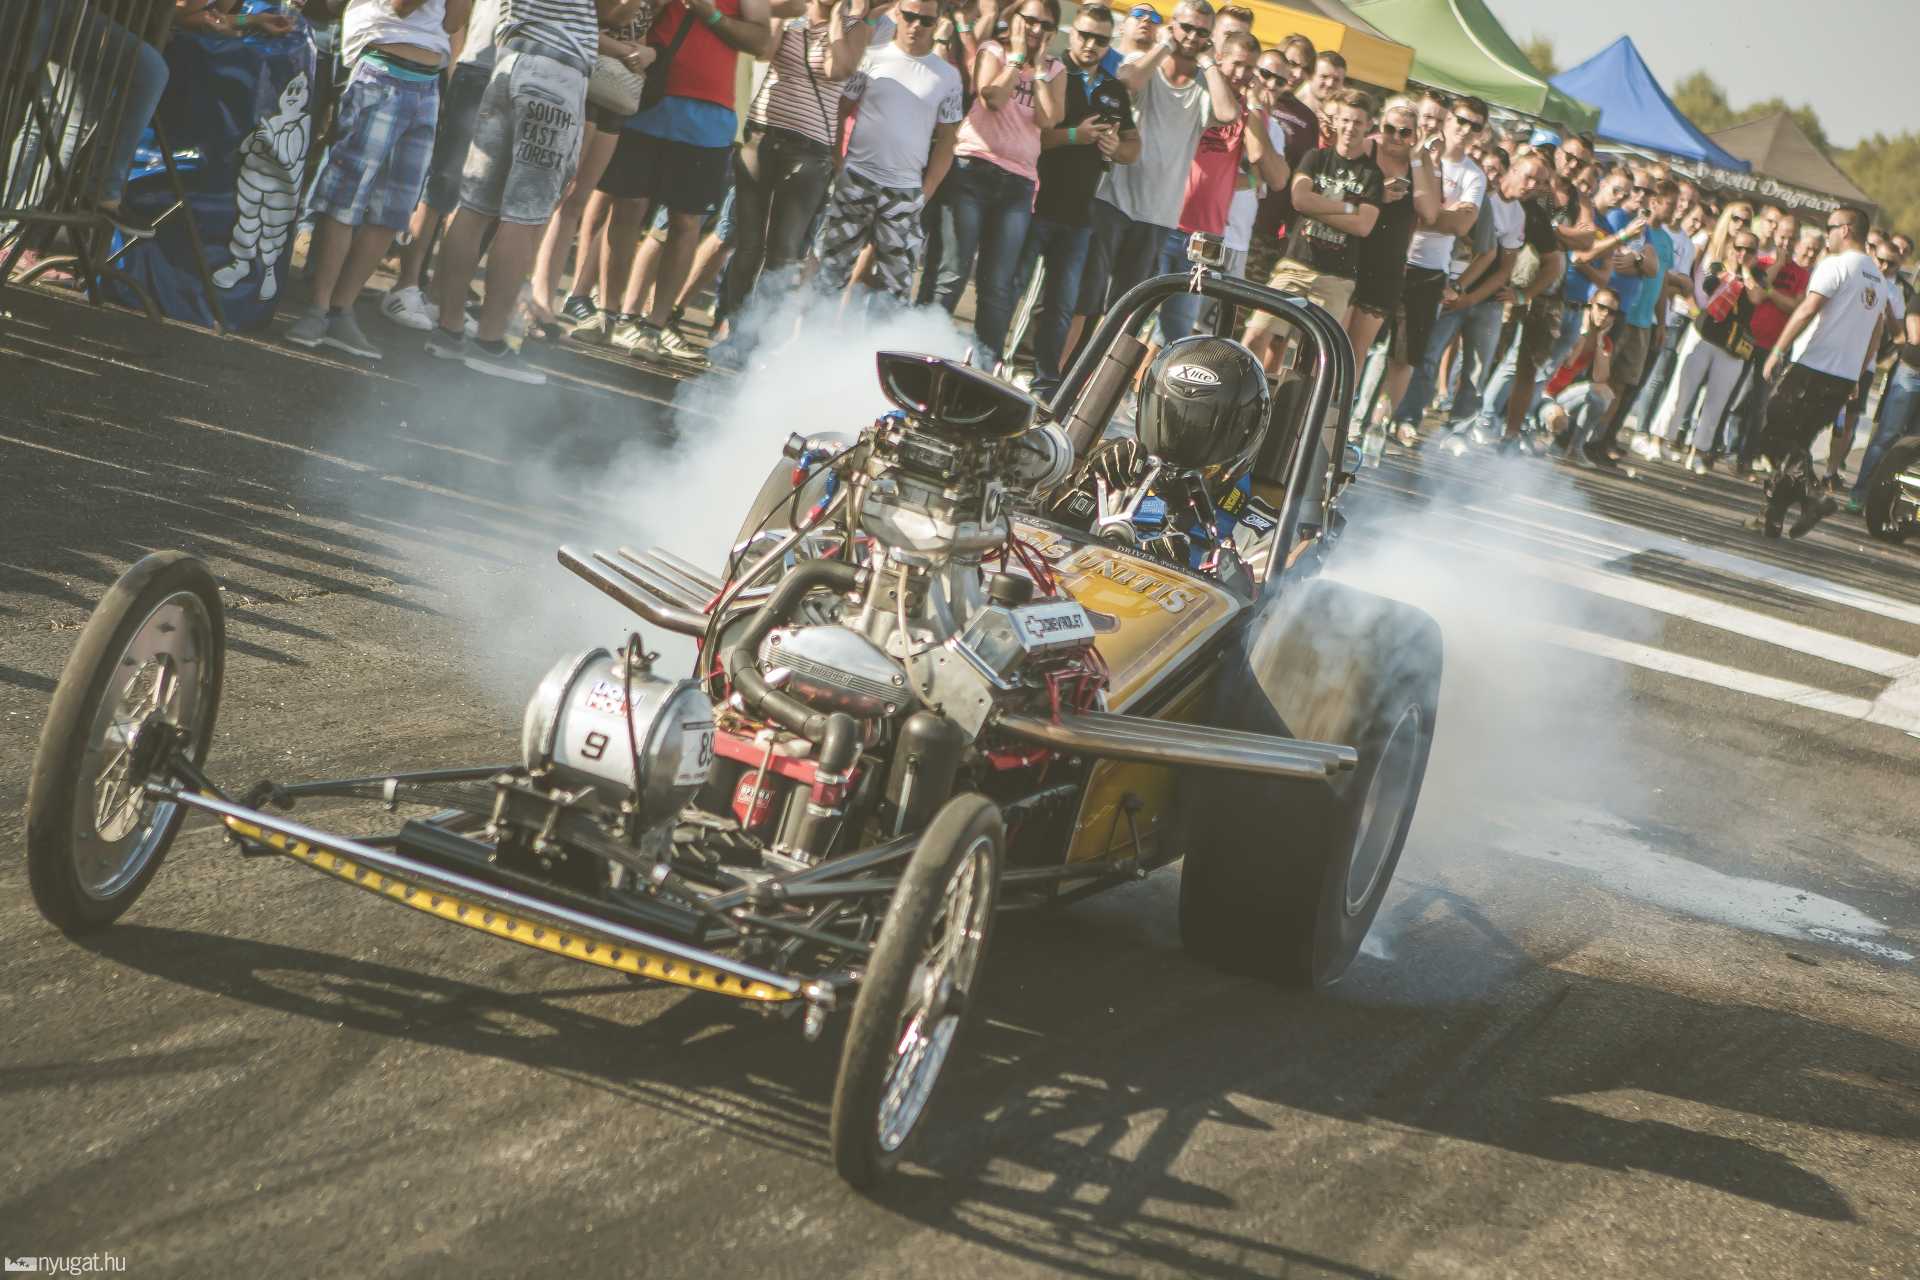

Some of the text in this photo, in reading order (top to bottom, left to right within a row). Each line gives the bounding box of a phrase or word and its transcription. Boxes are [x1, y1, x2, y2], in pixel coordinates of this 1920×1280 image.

[522, 121, 558, 147] EAST
[516, 141, 564, 169] FOREST
[580, 731, 609, 760] 9
